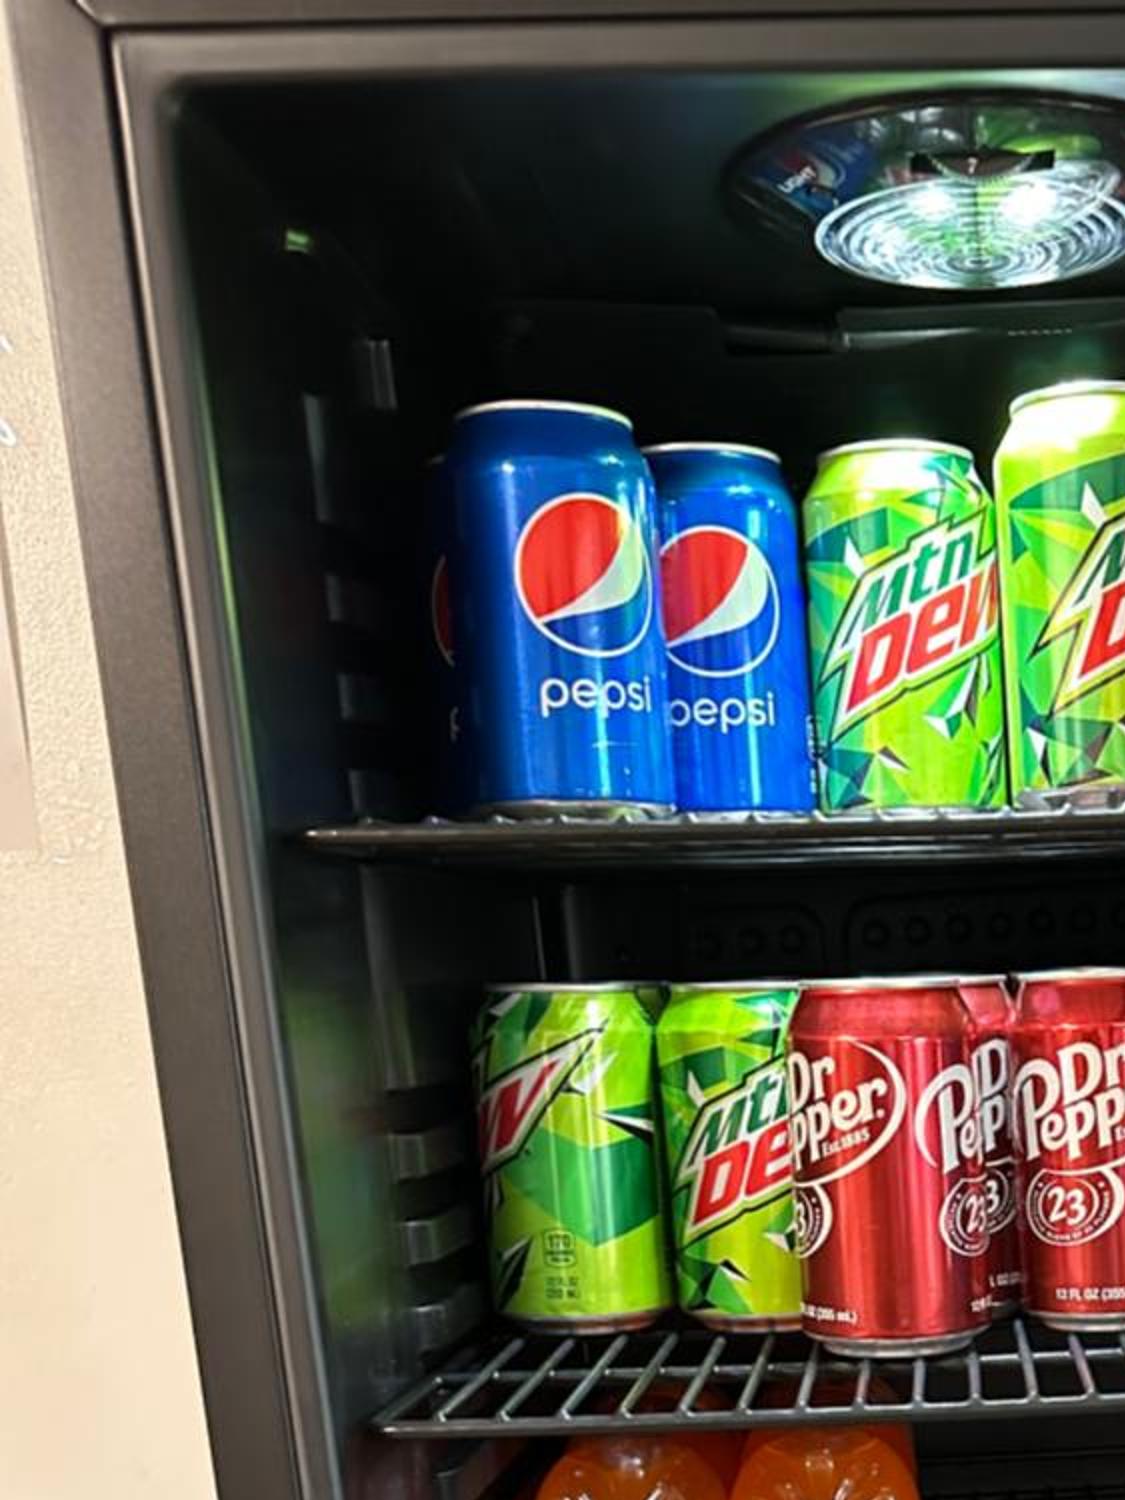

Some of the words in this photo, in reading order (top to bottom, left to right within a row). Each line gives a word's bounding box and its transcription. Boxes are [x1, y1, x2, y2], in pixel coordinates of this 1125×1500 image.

[842, 530, 973, 648] Mtn
[539, 676, 652, 718] pepsi
[787, 1051, 836, 1115] Dr
[1047, 1186, 1088, 1226] 23
